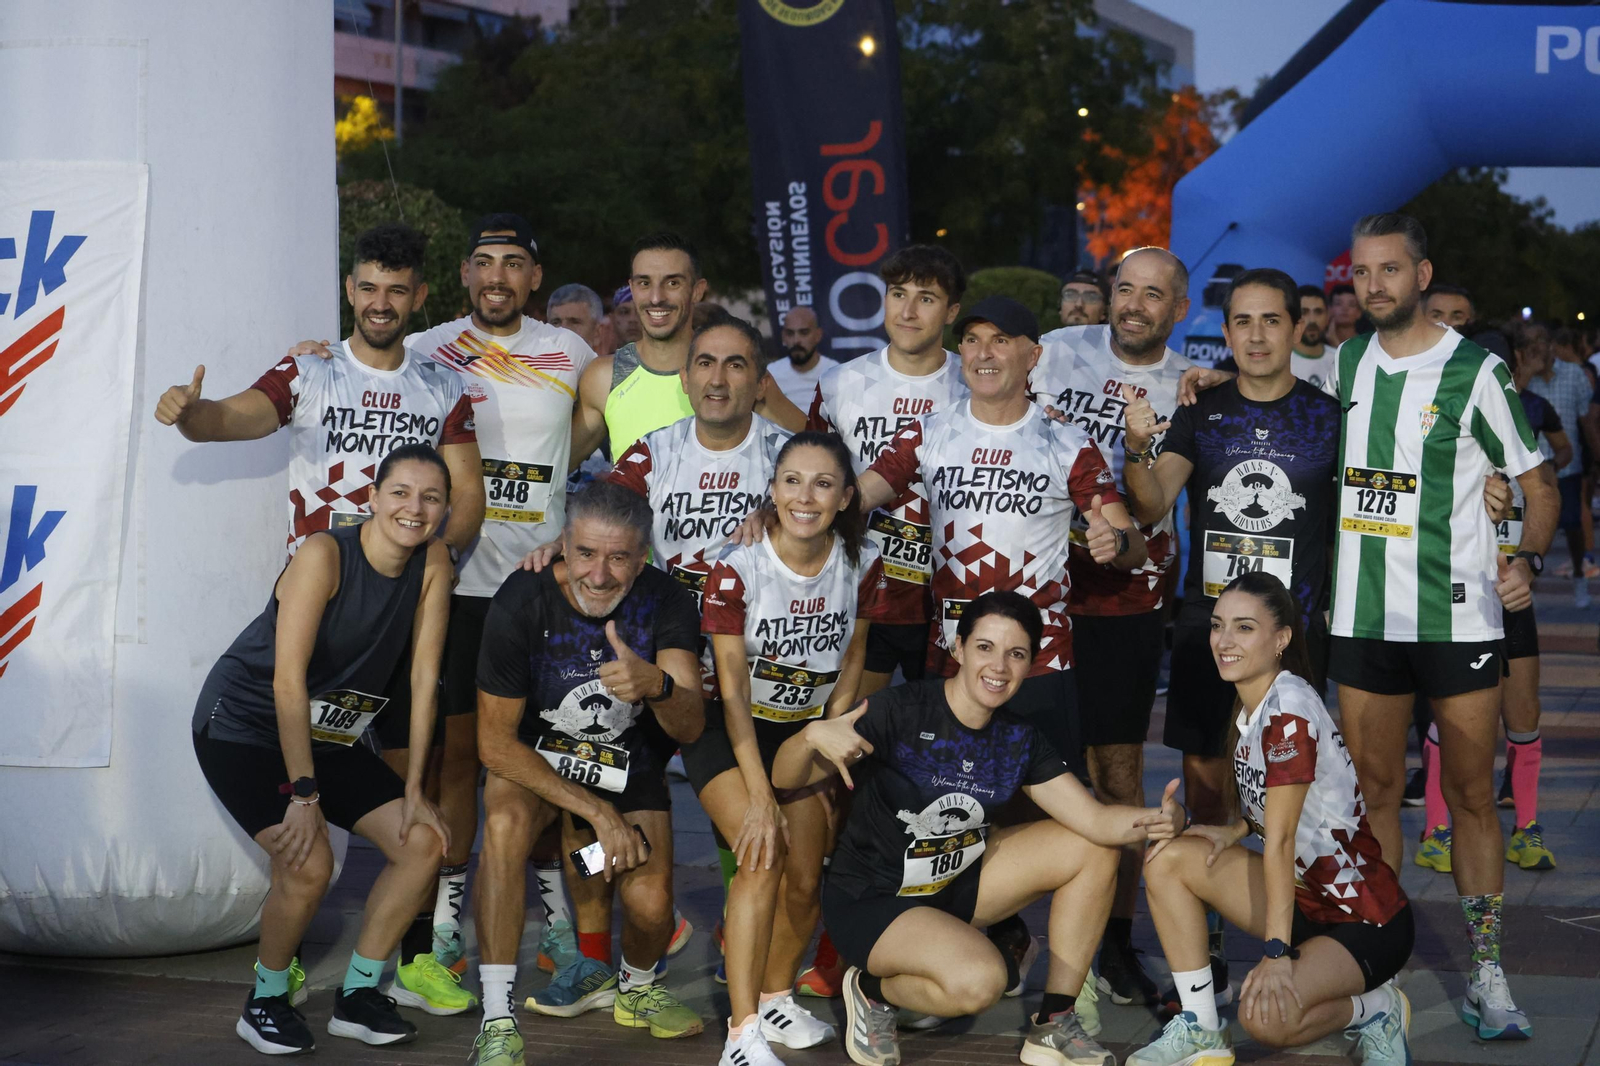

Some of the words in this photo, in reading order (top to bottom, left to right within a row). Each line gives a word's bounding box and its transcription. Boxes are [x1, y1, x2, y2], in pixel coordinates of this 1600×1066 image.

[361, 390, 402, 409] CLUB
[892, 397, 934, 415] CLUB
[322, 406, 439, 437] ATLETISMO
[971, 447, 1013, 466] CLUB
[489, 478, 530, 504] 348
[699, 472, 740, 490] CLUB
[932, 466, 1051, 493] ATLETISMO
[661, 491, 763, 518] ATLETISM
[938, 489, 1043, 518] MONTORO
[1357, 489, 1398, 515] 1273
[881, 535, 932, 565] 1258
[1226, 555, 1264, 577] 784
[789, 597, 826, 614] CLUB
[769, 683, 815, 706] 233
[317, 704, 362, 730] 1489
[557, 755, 603, 786] 856
[930, 850, 964, 877] 180
